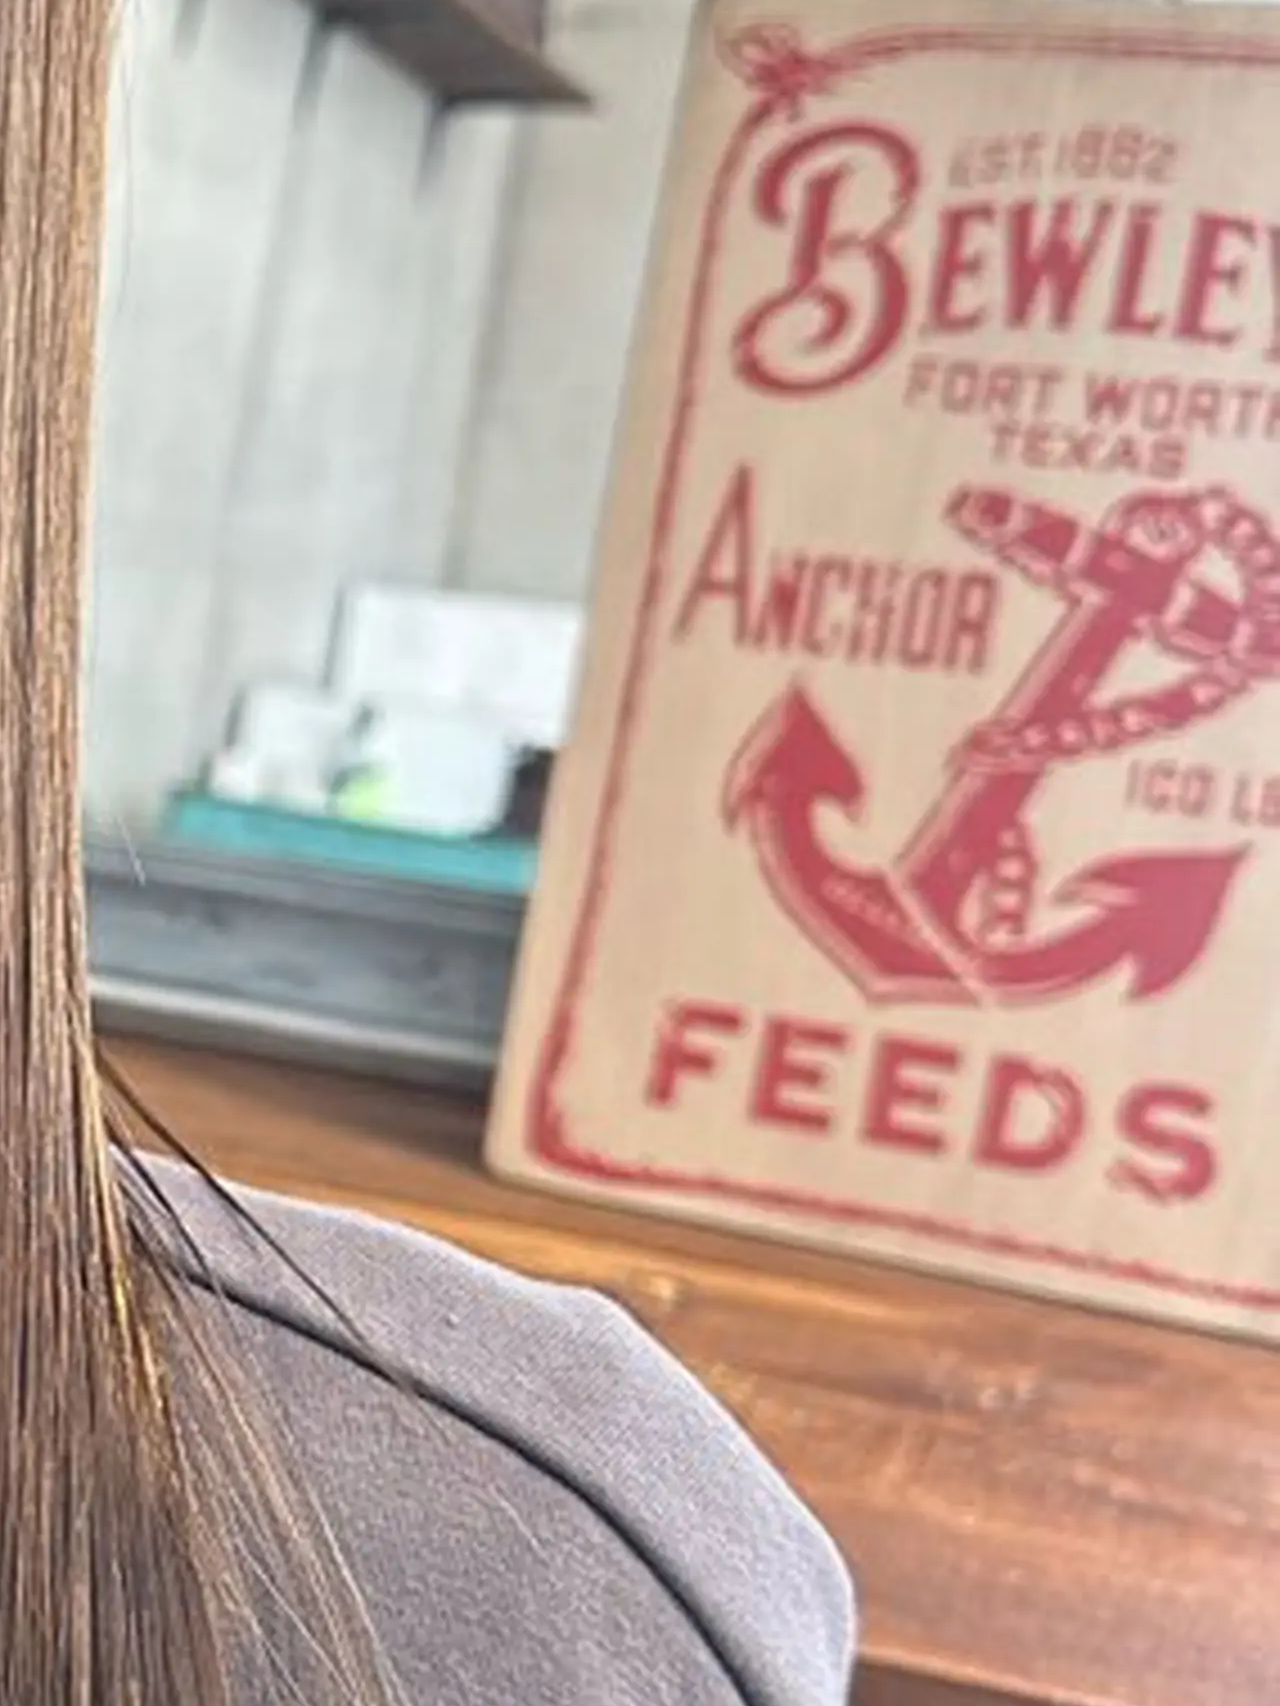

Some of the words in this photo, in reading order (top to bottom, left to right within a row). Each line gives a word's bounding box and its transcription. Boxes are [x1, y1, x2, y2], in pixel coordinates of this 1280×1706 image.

[733, 122, 1280, 398] BEWLE
[902, 356, 1064, 414] FORT
[990, 421, 1188, 478] TEXAS
[672, 461, 998, 675] ANCHOR
[645, 999, 1217, 1205] FEEDS
